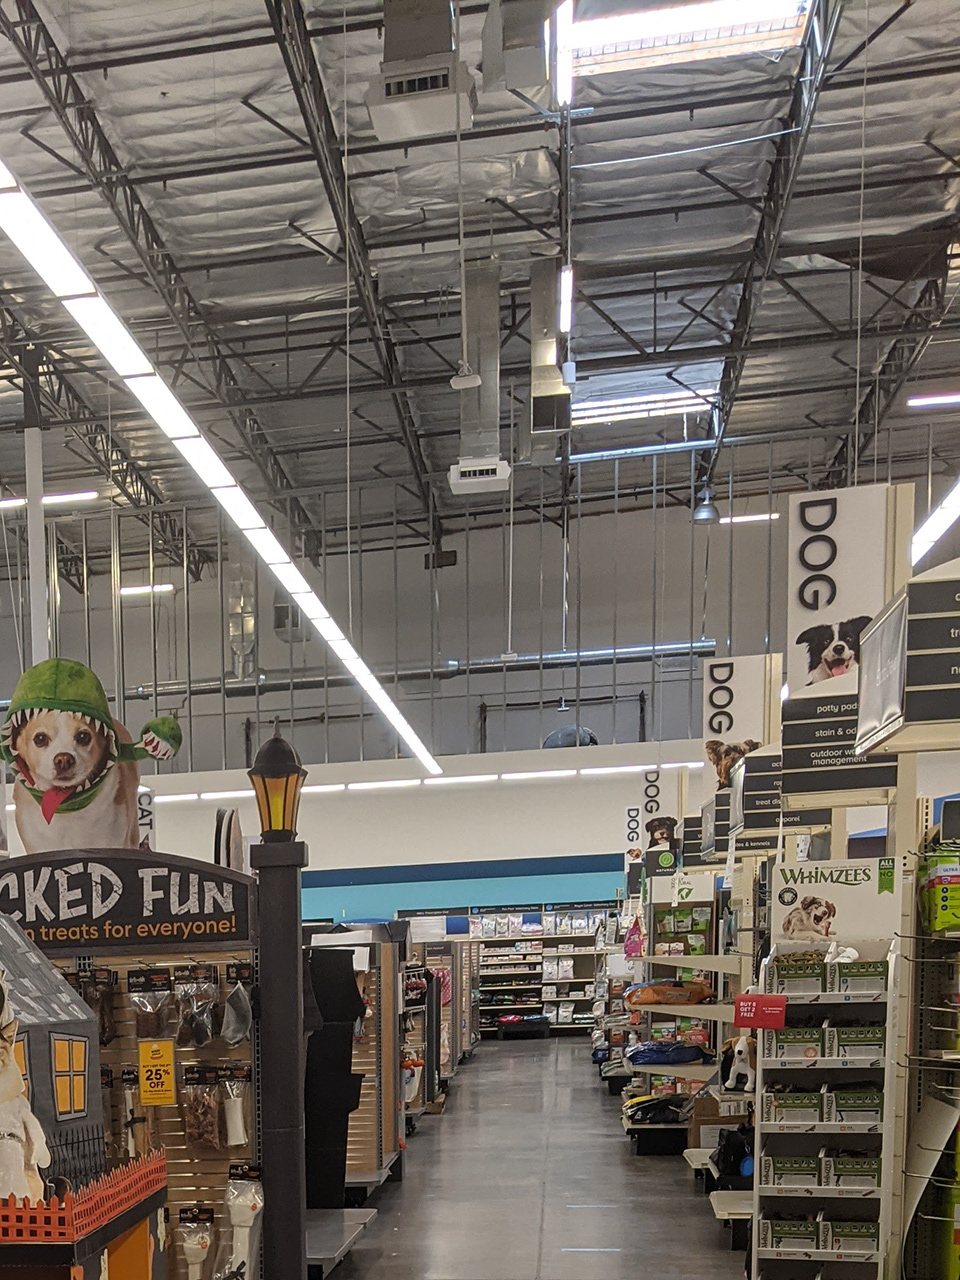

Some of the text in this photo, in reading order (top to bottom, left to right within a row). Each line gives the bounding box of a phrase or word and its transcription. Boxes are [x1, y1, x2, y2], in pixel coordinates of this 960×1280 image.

[799, 497, 838, 611] DOG
[708, 662, 734, 735] DOG
[816, 702, 858, 714] potty pad
[815, 728, 835, 737] stain
[810, 749, 843, 758] outdoor
[812, 755, 867, 766] management
[644, 770, 660, 814] DOG
[137, 793, 153, 830] CAT
[775, 815, 800, 823] aparel
[627, 808, 640, 842] DOG
[137, 867, 235, 917] FUN
[40, 923, 99, 941] treats
[103, 920, 132, 938] for
[136, 915, 237, 939] everyone!
[149, 1081, 165, 1089] OFF
